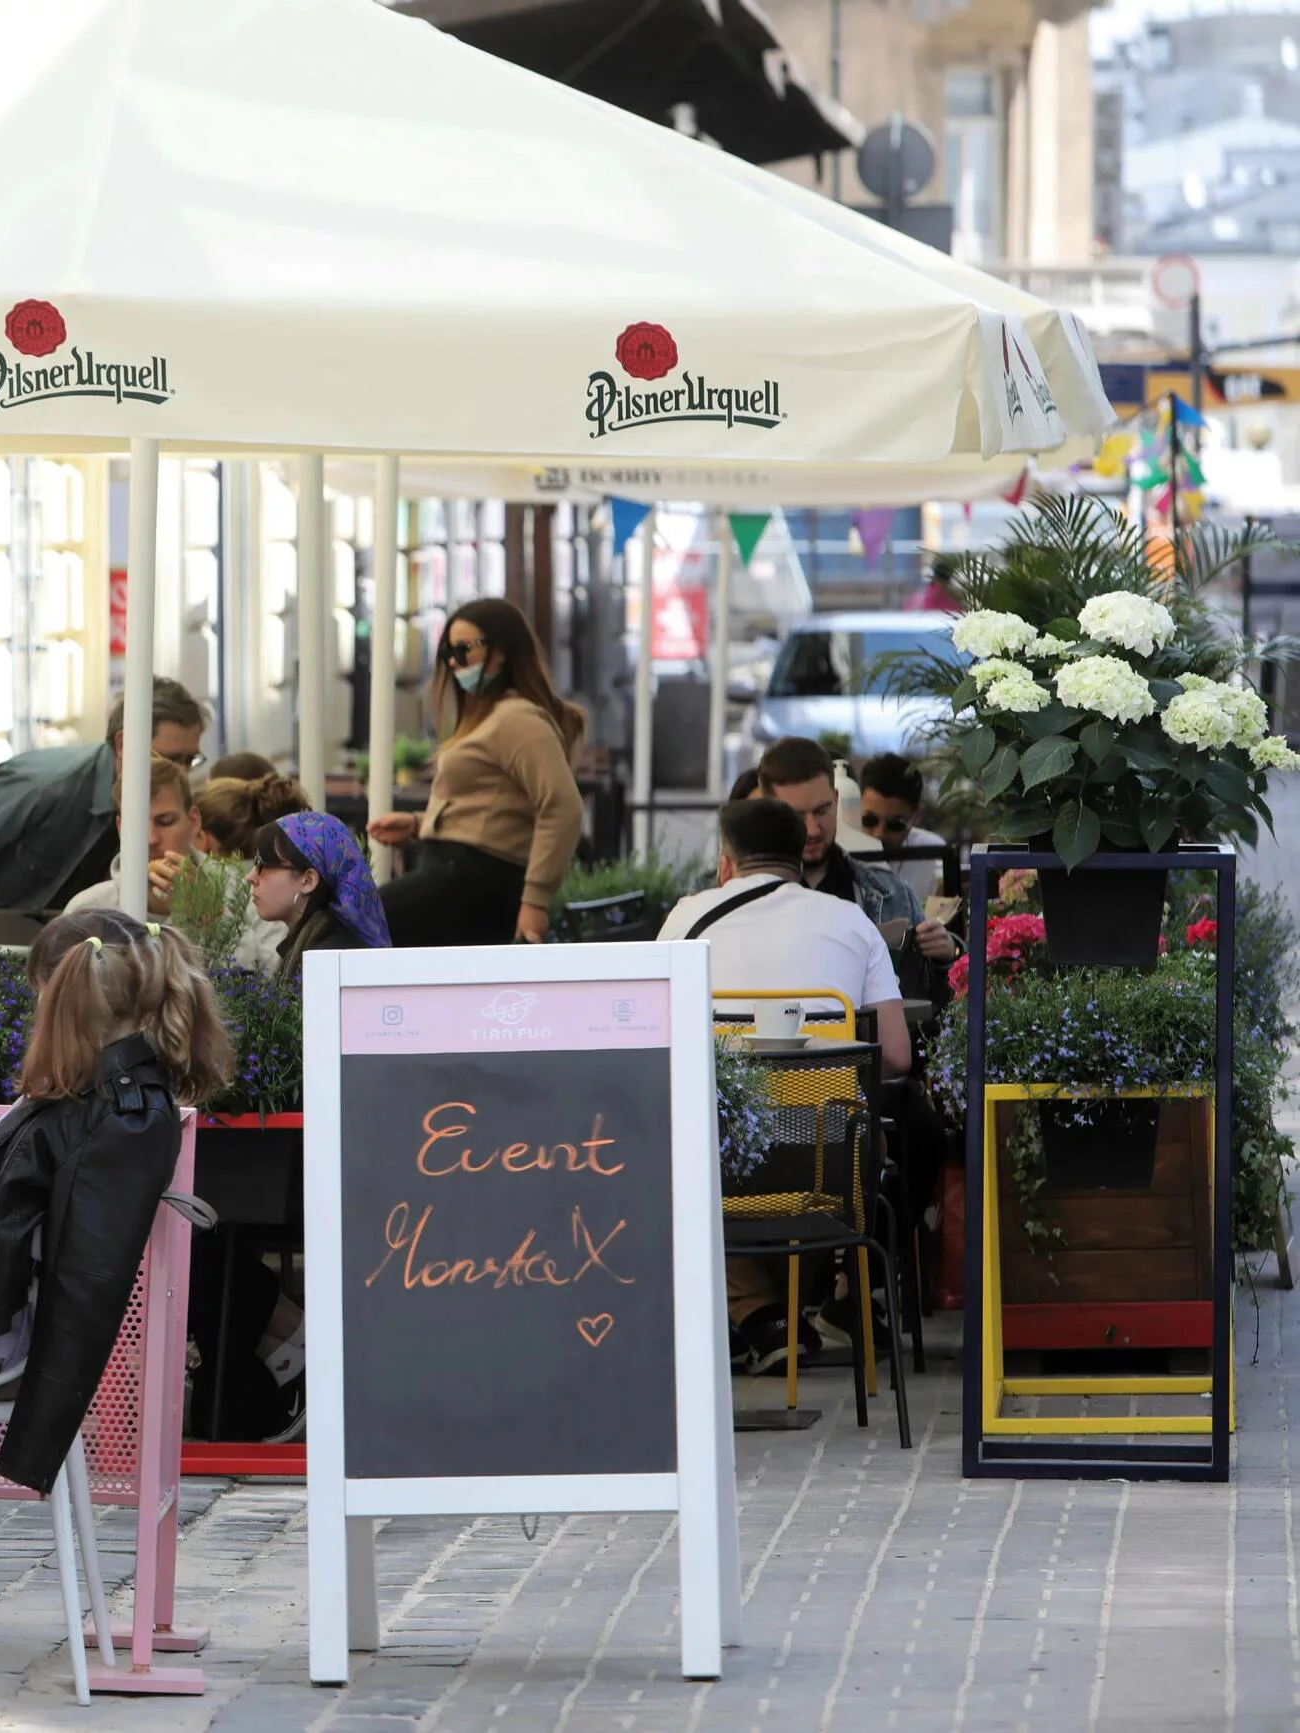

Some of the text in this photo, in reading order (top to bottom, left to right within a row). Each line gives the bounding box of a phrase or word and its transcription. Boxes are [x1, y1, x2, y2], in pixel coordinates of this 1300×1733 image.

[71, 346, 168, 405] Urquell
[585, 370, 780, 439] Pilsner Urquell
[417, 1101, 625, 1176] Event
